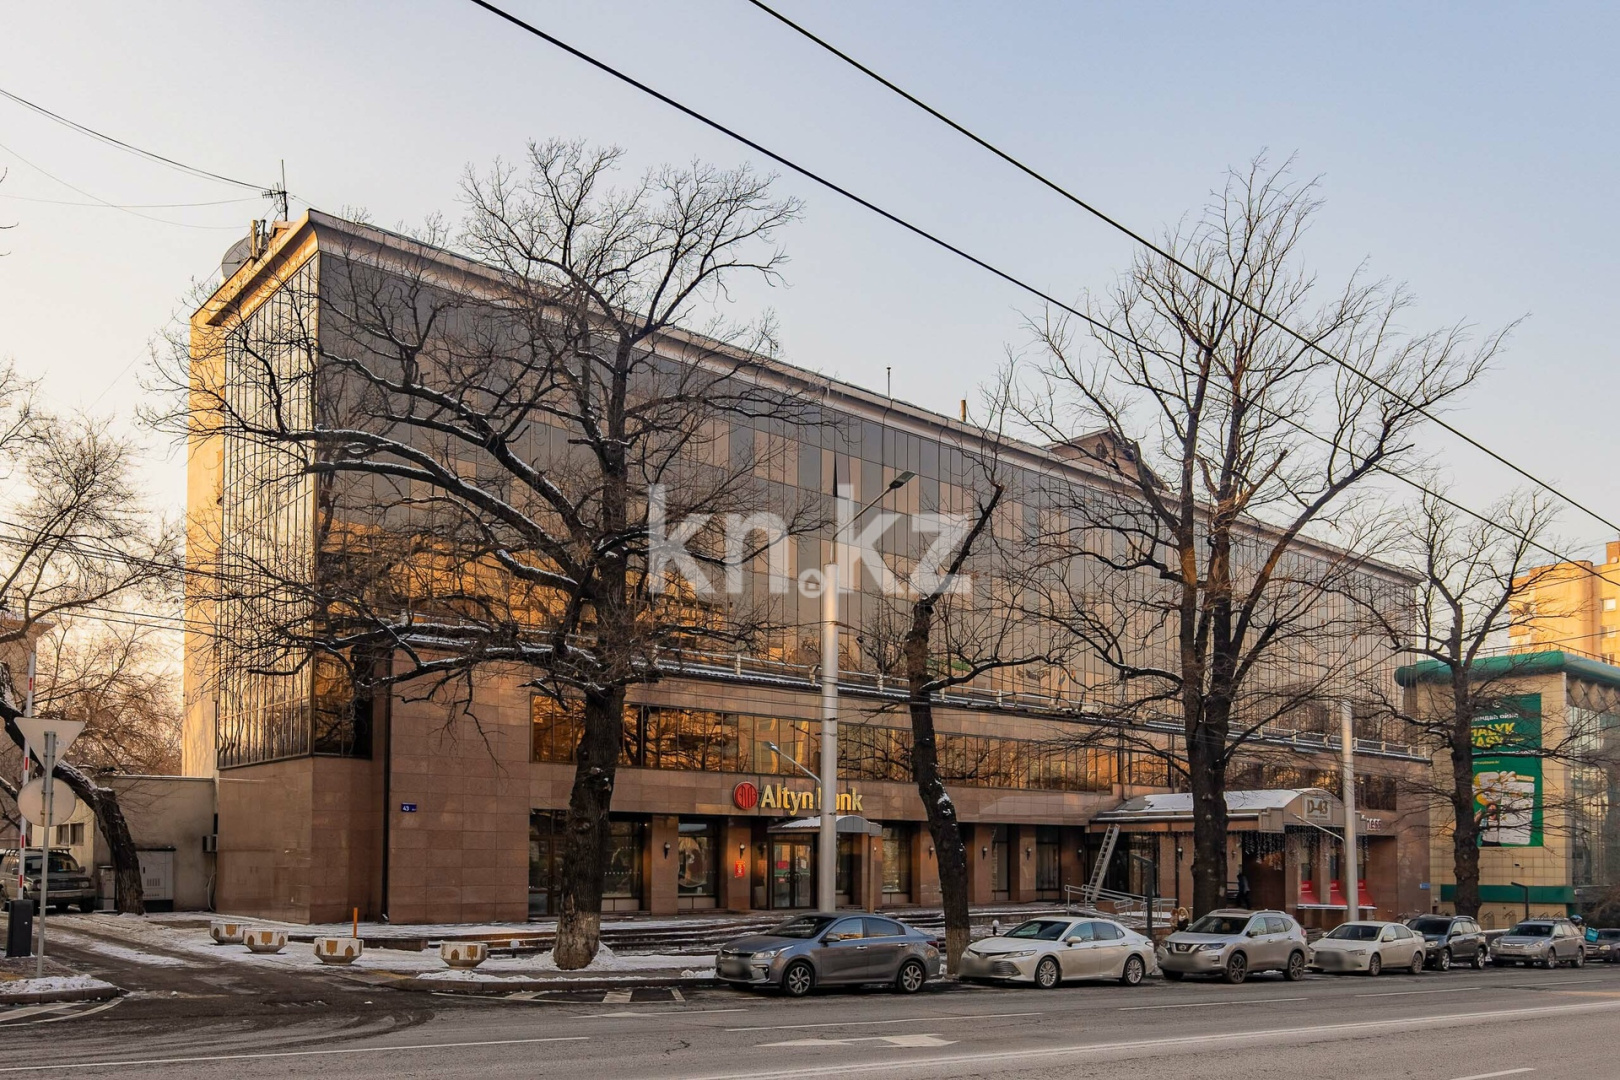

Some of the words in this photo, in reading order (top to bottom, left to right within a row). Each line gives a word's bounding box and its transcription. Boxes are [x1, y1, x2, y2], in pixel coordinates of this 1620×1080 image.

[760, 783, 813, 816] Altyn
[816, 787, 863, 812] nk
[1307, 799, 1328, 814] D-43
